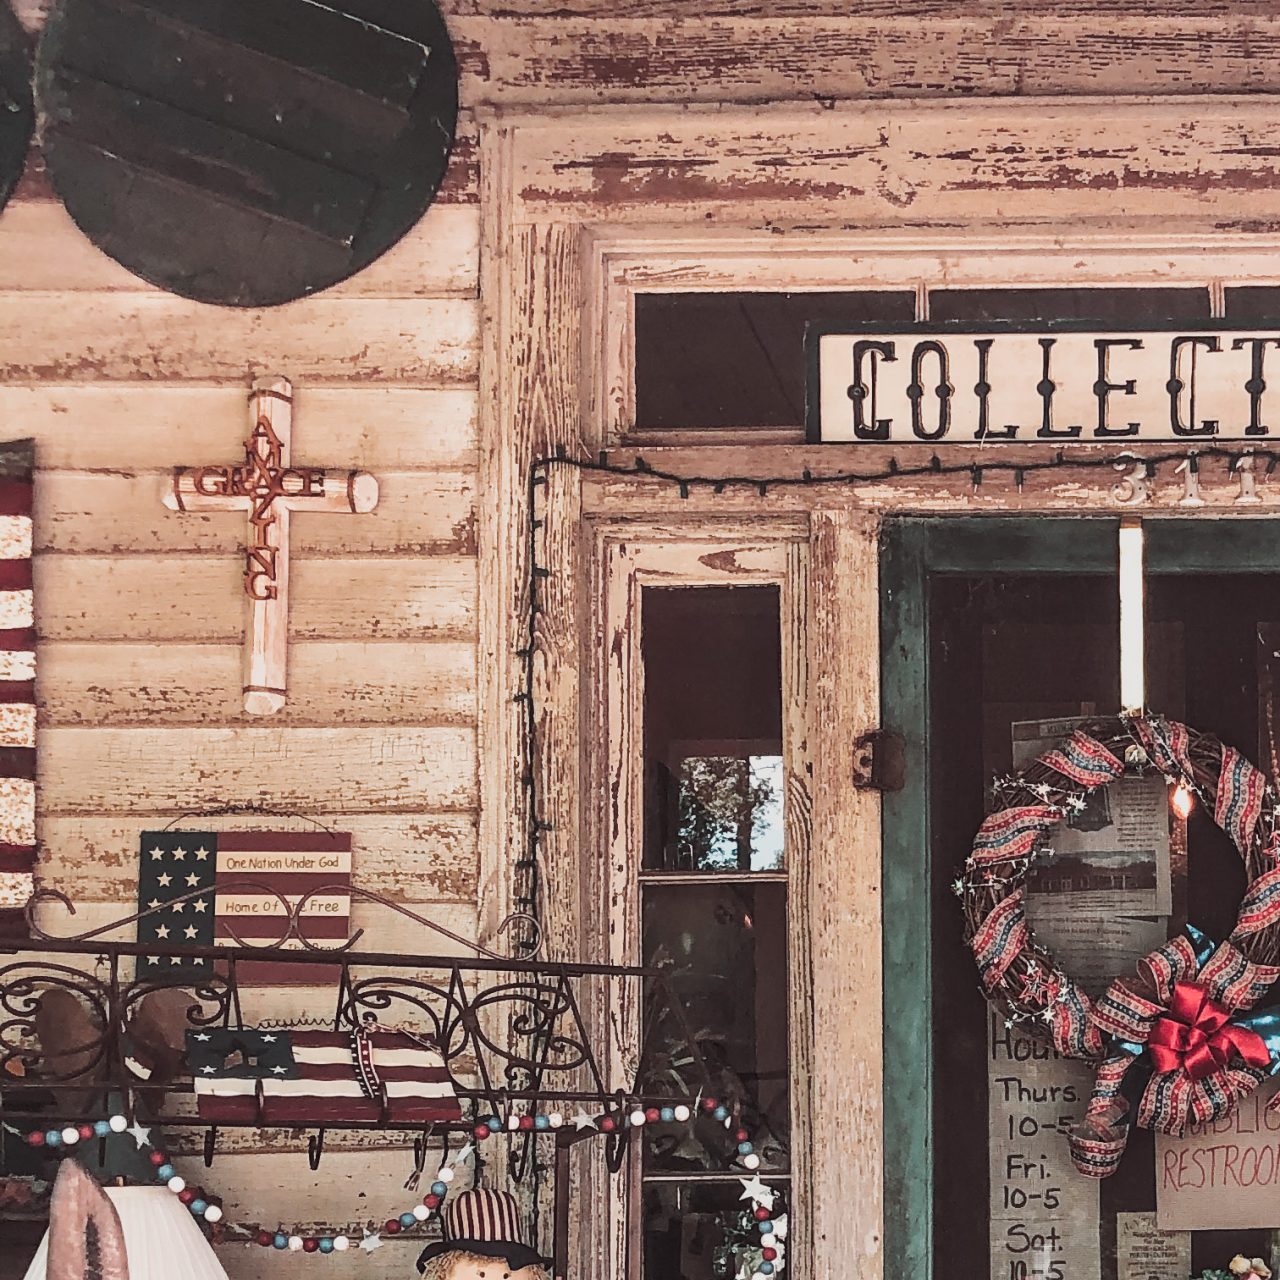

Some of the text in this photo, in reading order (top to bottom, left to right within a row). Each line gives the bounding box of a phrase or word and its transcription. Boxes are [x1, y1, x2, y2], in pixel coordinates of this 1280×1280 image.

[226, 855, 339, 870] One Nation Under God
[225, 901, 259, 913] Home
[262, 901, 279, 912] Of
[310, 899, 340, 912] Free
[994, 1076, 1081, 1103] Thurs.
[1009, 1114, 1075, 1141] 10-5
[1006, 1153, 1051, 1180] Fri.
[1003, 1184, 1062, 1210] 10-5
[1005, 1223, 1063, 1254] Sat.
